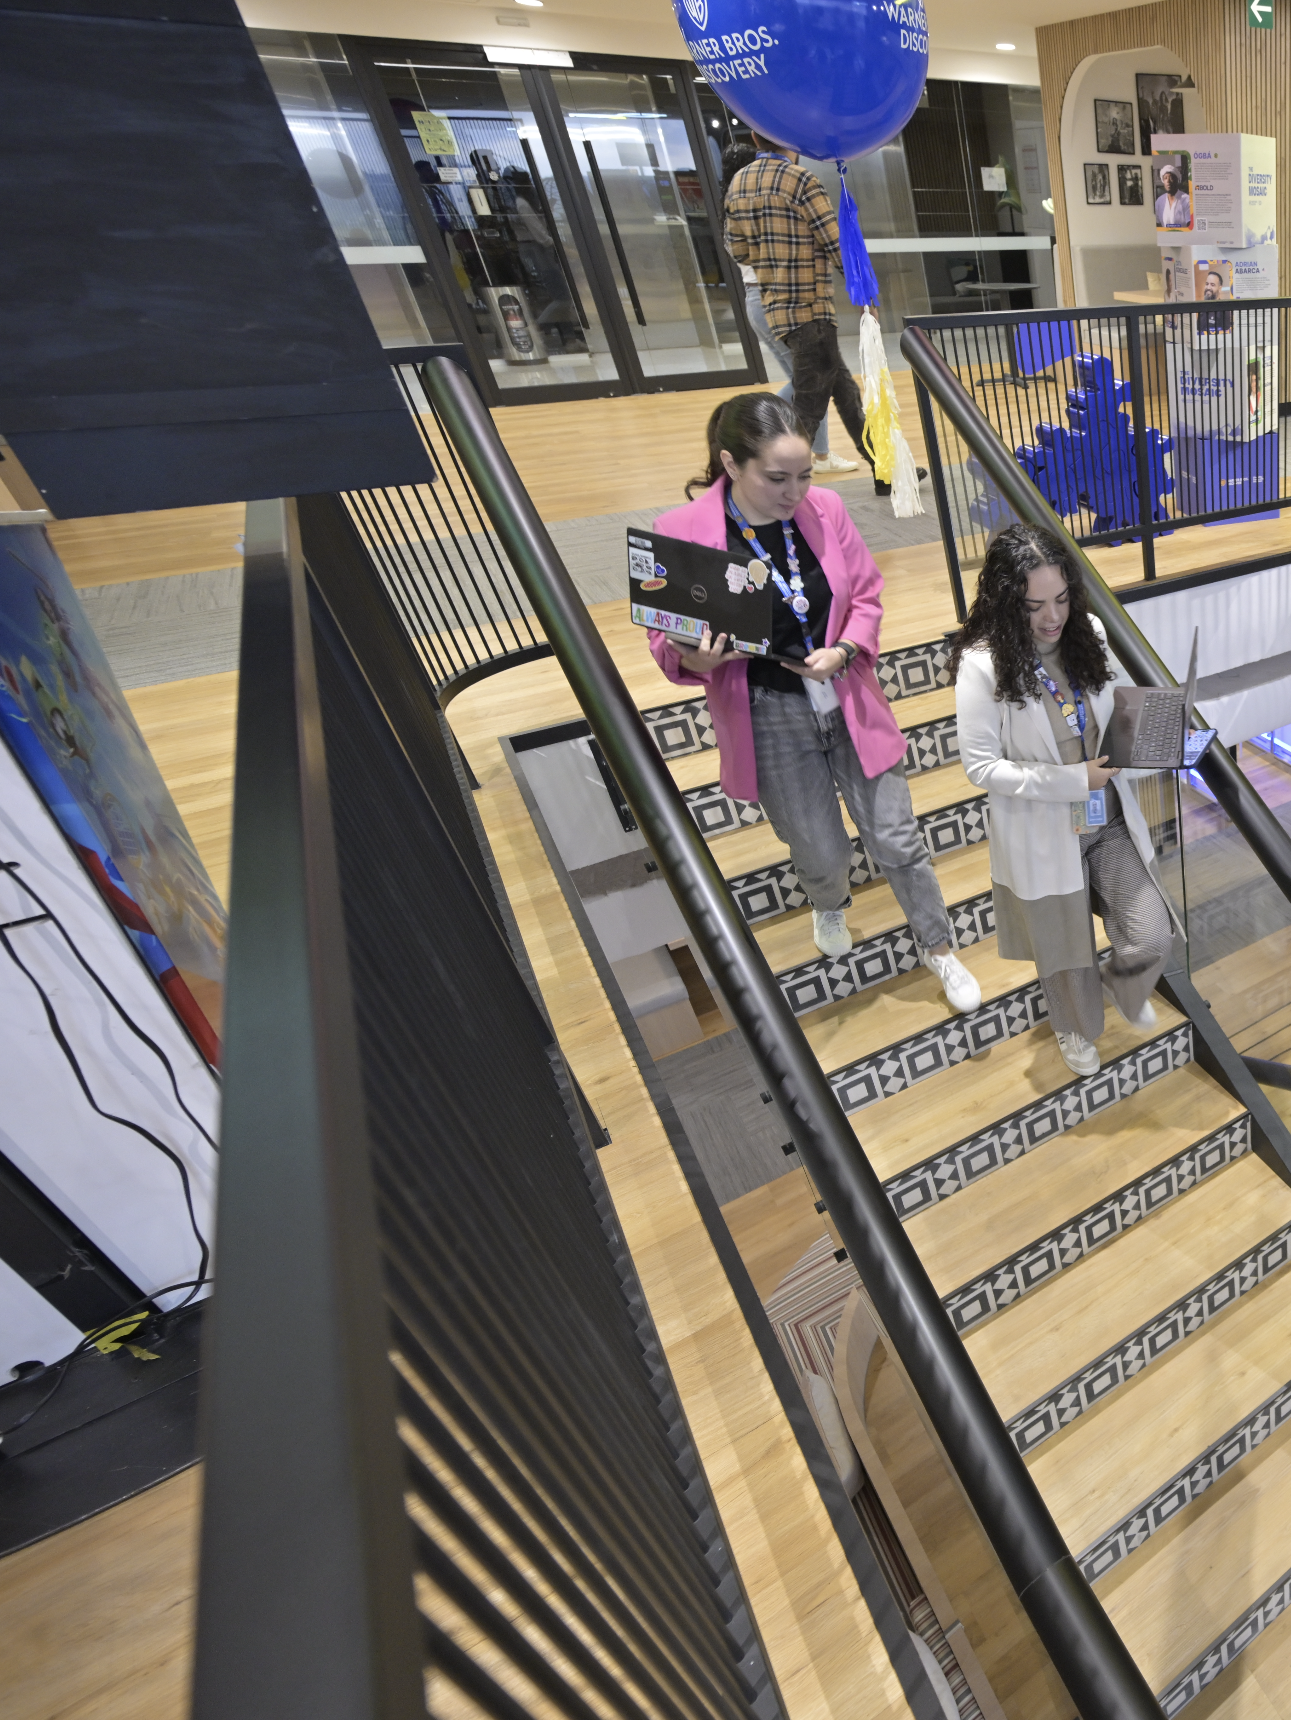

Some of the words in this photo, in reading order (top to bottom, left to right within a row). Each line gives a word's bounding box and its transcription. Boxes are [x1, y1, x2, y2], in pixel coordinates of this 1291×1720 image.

[721, 25, 779, 56] BROS.
[1248, 173, 1272, 184] DIVERSITY
[1248, 185, 1267, 197] MOSAIC
[1235, 267, 1260, 275] ABARCA
[1180, 376, 1234, 388] DIVERSITY
[1180, 386, 1222, 398] MOSAIC
[634, 607, 672, 629] ALWAYS
[674, 616, 709, 636] PROUD
